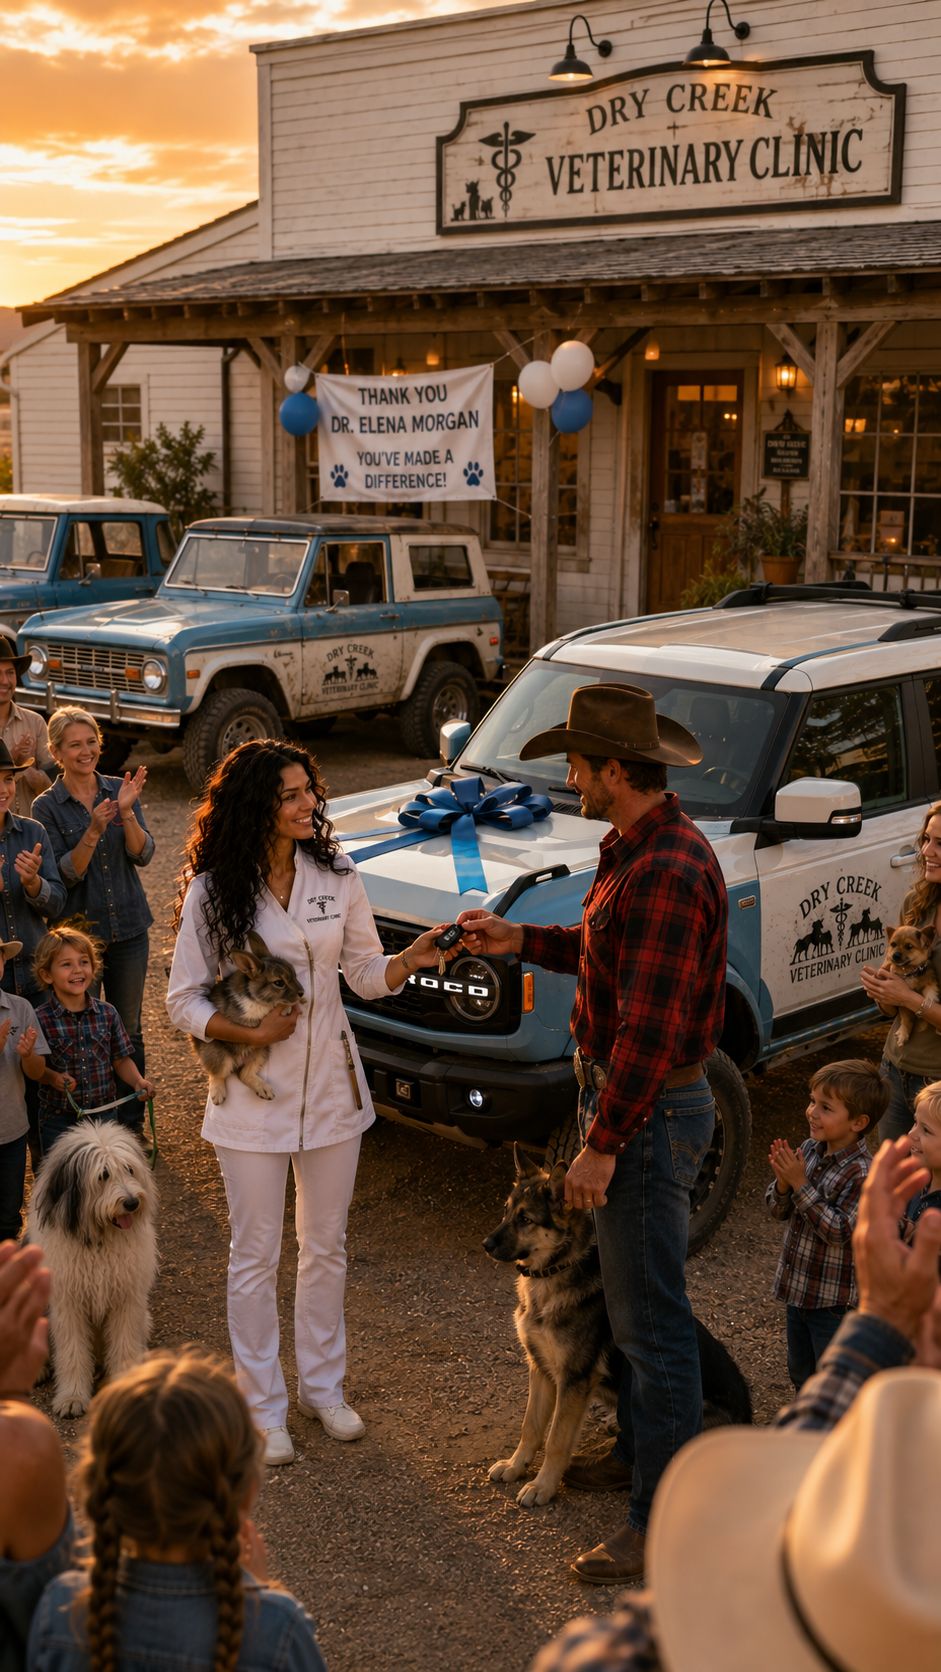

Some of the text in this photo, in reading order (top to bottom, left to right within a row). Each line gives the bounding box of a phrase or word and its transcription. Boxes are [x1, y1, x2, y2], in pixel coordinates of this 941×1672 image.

[586, 82, 778, 136] DRY CREEK
[545, 128, 863, 196] VETERINARY CLINIC
[358, 384, 448, 405] THANK YOU
[331, 410, 479, 434] DR. ELENA MORGAN
[357, 449, 454, 466] YOU'VE MADE A
[365, 472, 447, 489] DIFFERENCE!
[326, 643, 375, 662] DRY CREEK
[799, 875, 882, 919] DRY CREEK
[790, 943, 885, 984] VETERINARY CLINIC
